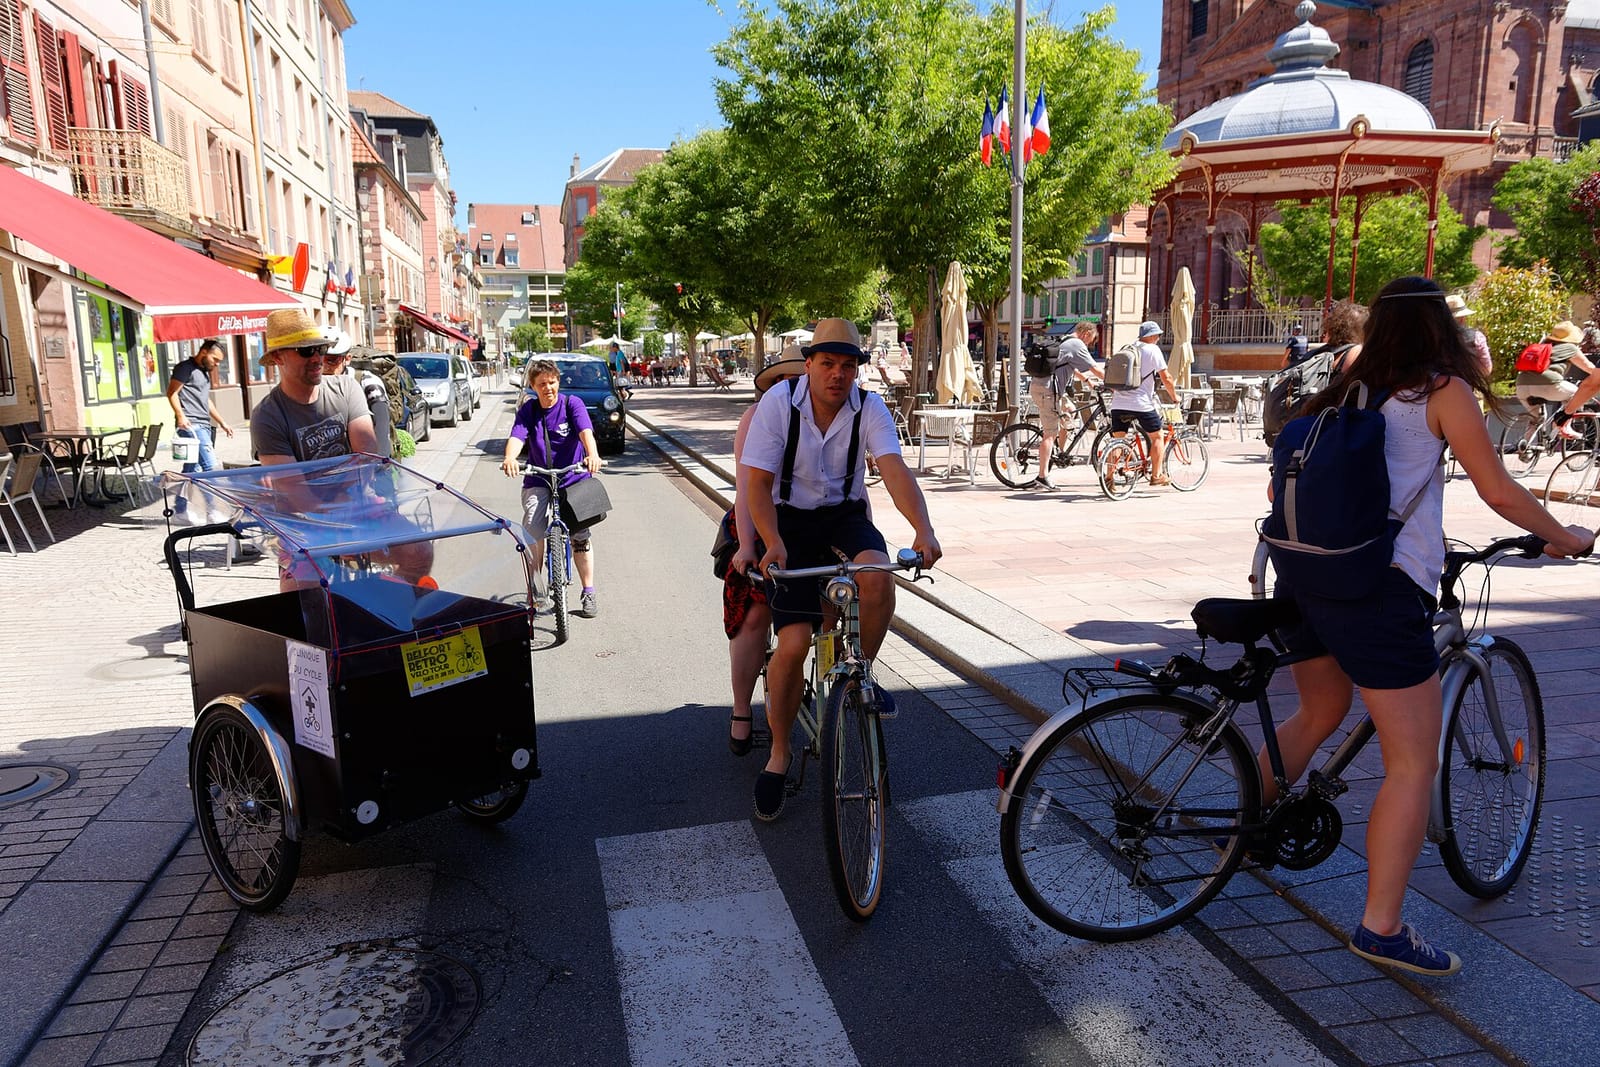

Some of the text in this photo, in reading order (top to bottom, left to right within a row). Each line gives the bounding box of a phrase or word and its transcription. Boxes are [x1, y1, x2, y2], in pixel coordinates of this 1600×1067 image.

[406, 642, 452, 662] BELFORT
[408, 653, 448, 673] RETRO
[410, 668, 429, 679] VELO
[430, 663, 450, 674] TOUR
[303, 667, 322, 681] CYCLE
